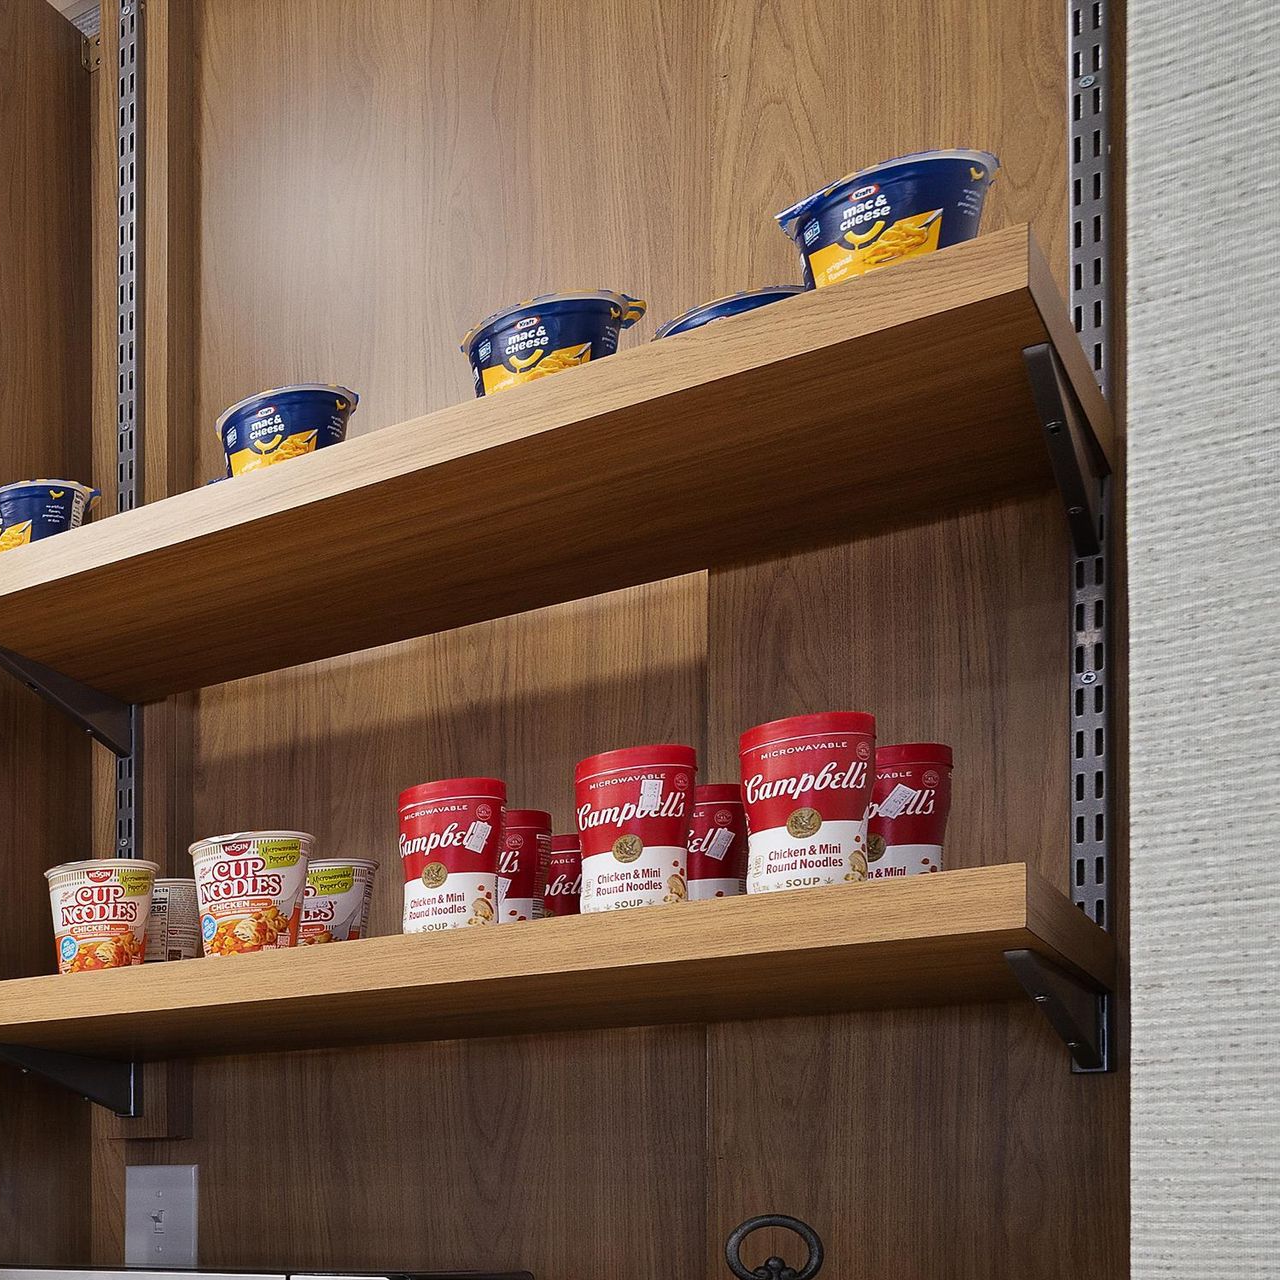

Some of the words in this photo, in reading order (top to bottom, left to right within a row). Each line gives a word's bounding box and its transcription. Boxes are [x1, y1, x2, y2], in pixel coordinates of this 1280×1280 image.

[854, 187, 873, 198] Kraft
[843, 199, 874, 219] mac
[874, 194, 887, 207] &
[508, 329, 536, 346] mac
[535, 325, 547, 337] &
[251, 418, 273, 431] mac
[273, 414, 282, 424] &
[760, 741, 848, 761] MICROWAVABLE
[590, 773, 666, 790] MICROWAVABLE
[744, 761, 868, 804] Campbell's
[404, 804, 469, 821] MICROWAVABLE
[225, 842, 248, 852] NISSIN
[262, 843, 299, 855] Microwavable
[768, 850, 807, 861] Chicken
[808, 847, 817, 856] &
[819, 844, 842, 855] Mini
[89, 870, 111, 879] NISSIN
[212, 858, 265, 880] CUP
[766, 861, 797, 875] Round
[799, 857, 843, 870] Noodles
[875, 868, 883, 878] &
[884, 866, 906, 877] Mini
[597, 871, 632, 885] Chicken
[632, 869, 641, 879] &
[641, 868, 661, 879] Mini
[785, 877, 821, 888] SOUP
[76, 885, 126, 905] CUP
[201, 874, 282, 905] NOODLES
[596, 883, 625, 896] Round
[625, 880, 663, 893] Noodles
[212, 901, 251, 911] CHICKEN
[410, 897, 437, 909] Chicken
[437, 895, 445, 904] &
[446, 892, 465, 903] Mini
[614, 899, 644, 909] SOUP
[61, 902, 137, 926] NOODLES
[408, 908, 430, 921] Round
[431, 904, 468, 917] Noodles
[73, 924, 111, 933] CHICKEN
[422, 922, 449, 933] SOUP
